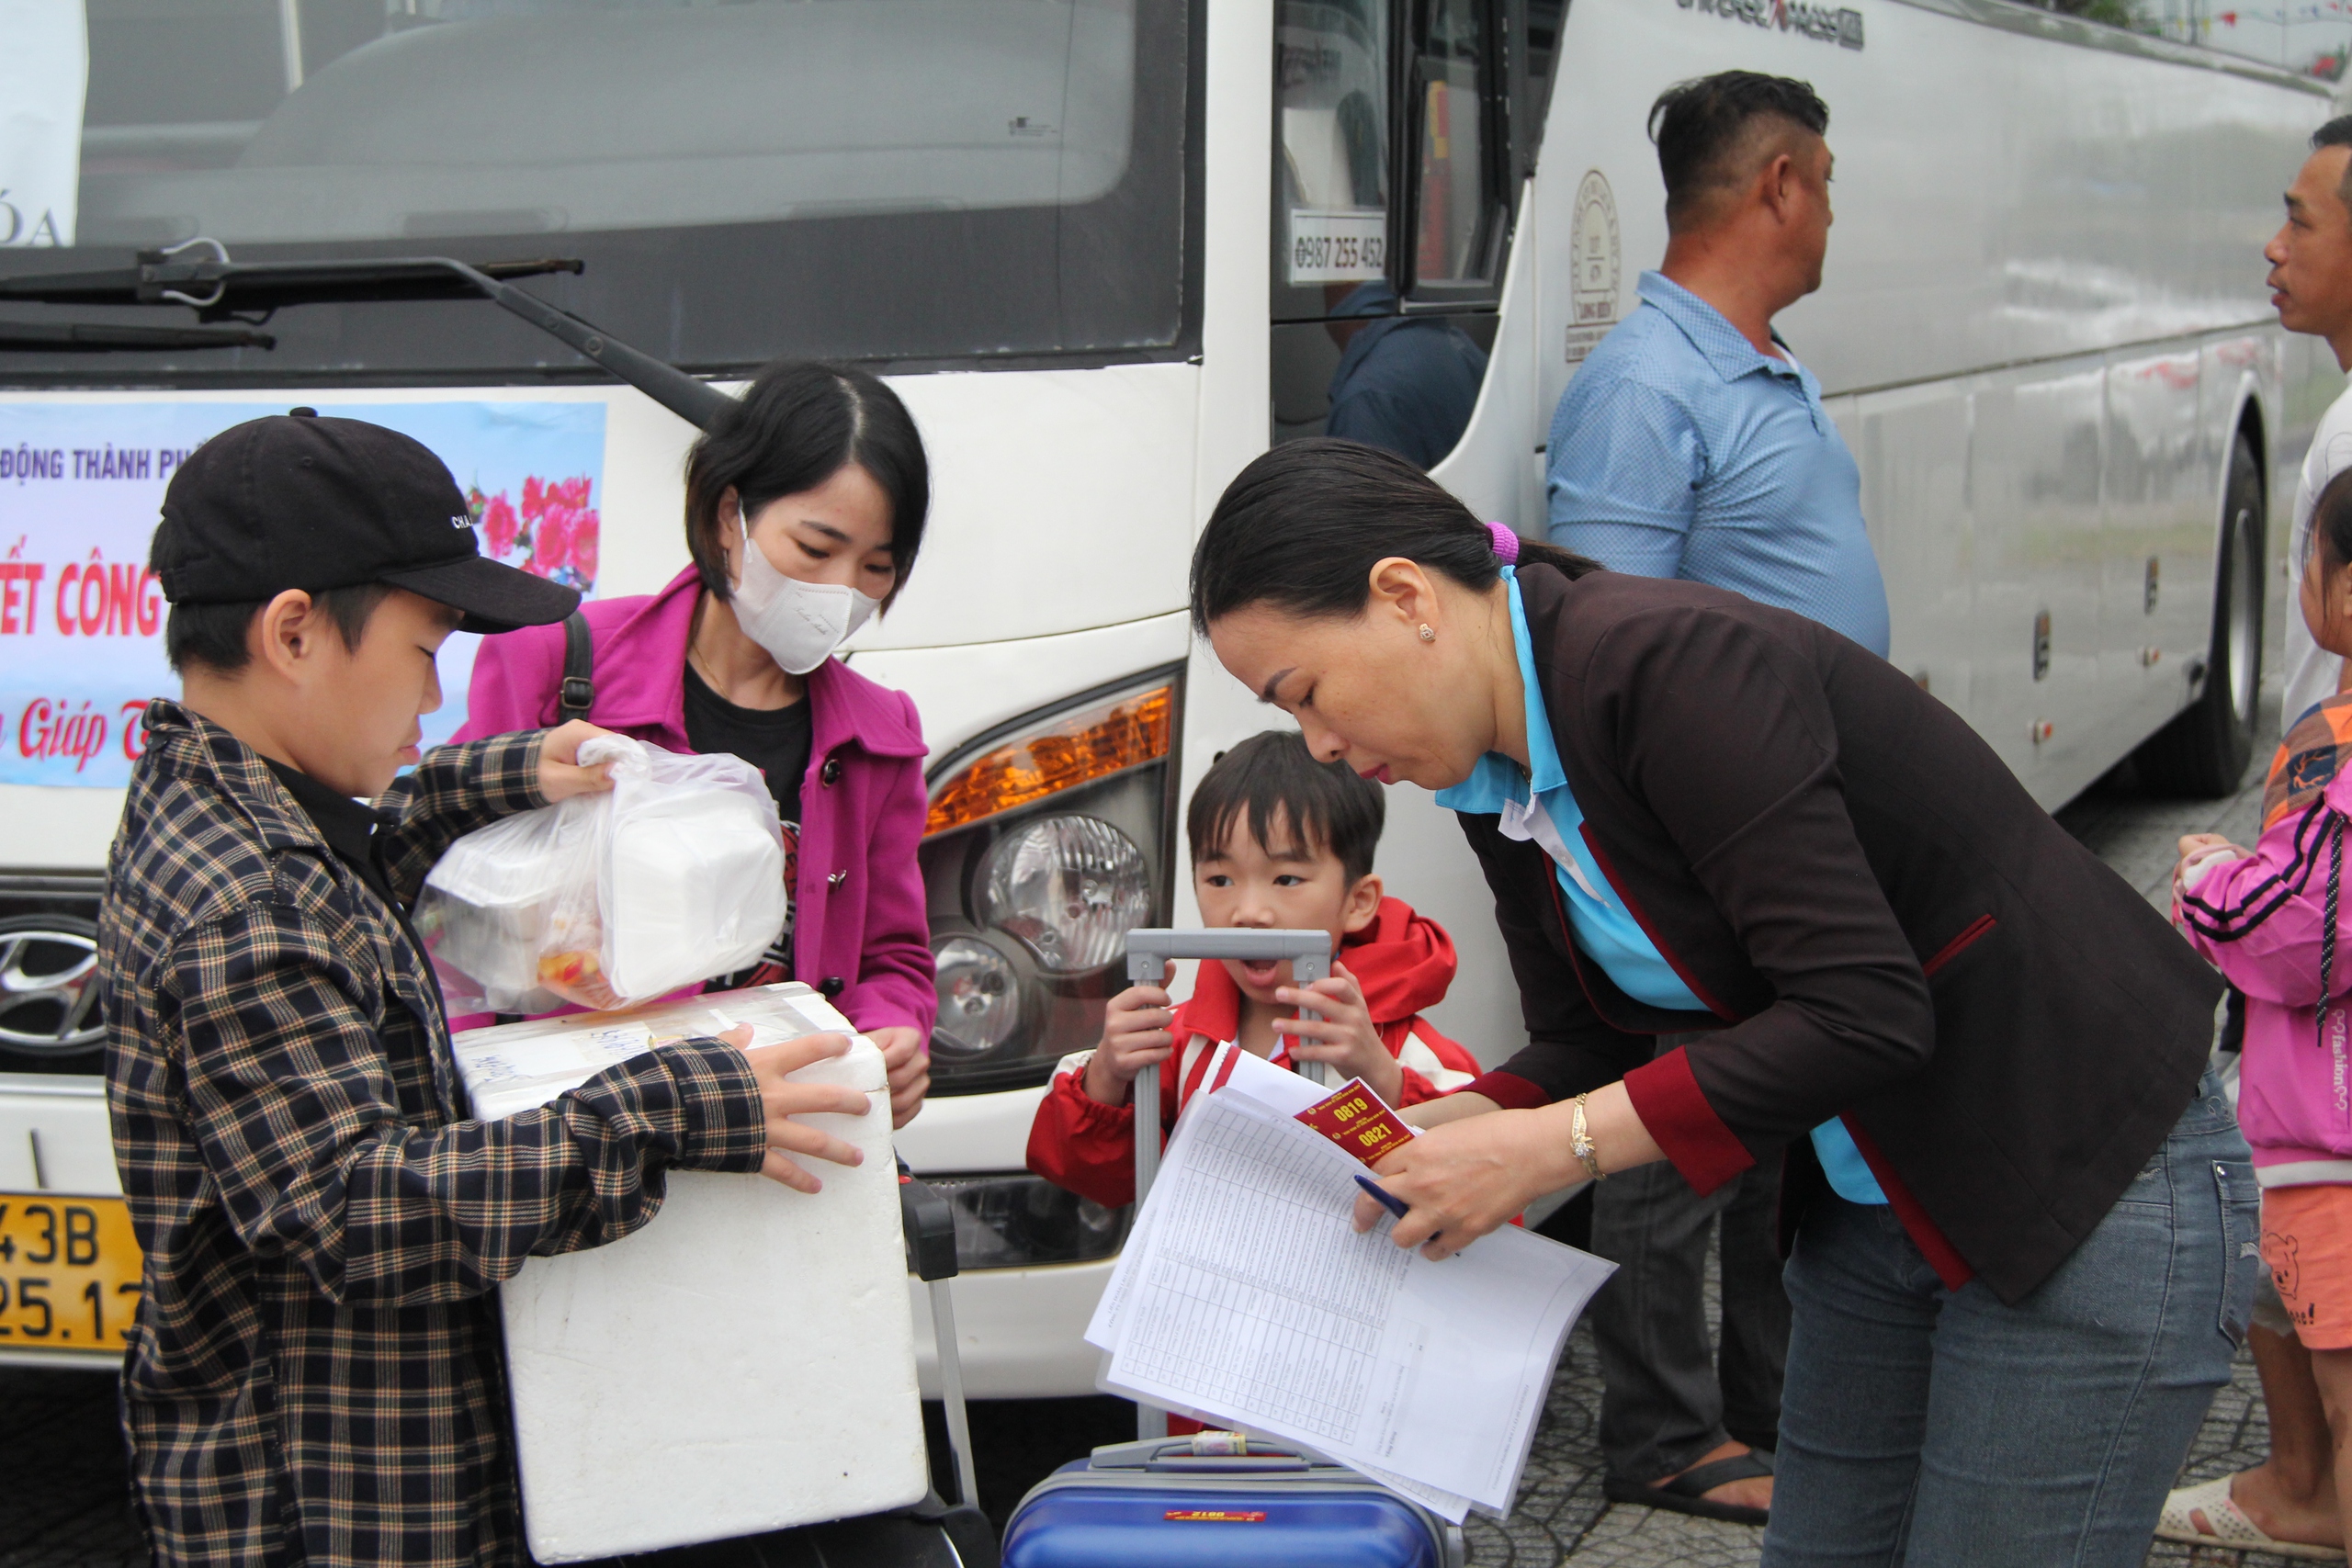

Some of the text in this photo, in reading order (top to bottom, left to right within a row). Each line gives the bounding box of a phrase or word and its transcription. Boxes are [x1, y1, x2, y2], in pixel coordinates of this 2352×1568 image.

[1335, 236, 1358, 268] 255
[1362, 236, 1383, 268] 452
[0, 438, 208, 486] ĐỘNG THÀNH PH
[0, 534, 162, 637] ẾT CÔNG
[18, 696, 108, 774] Giáp
[2332, 1034, 2348, 1086] fashion
[1333, 1097, 1368, 1122] 0819
[1358, 1122, 1393, 1147] 0821
